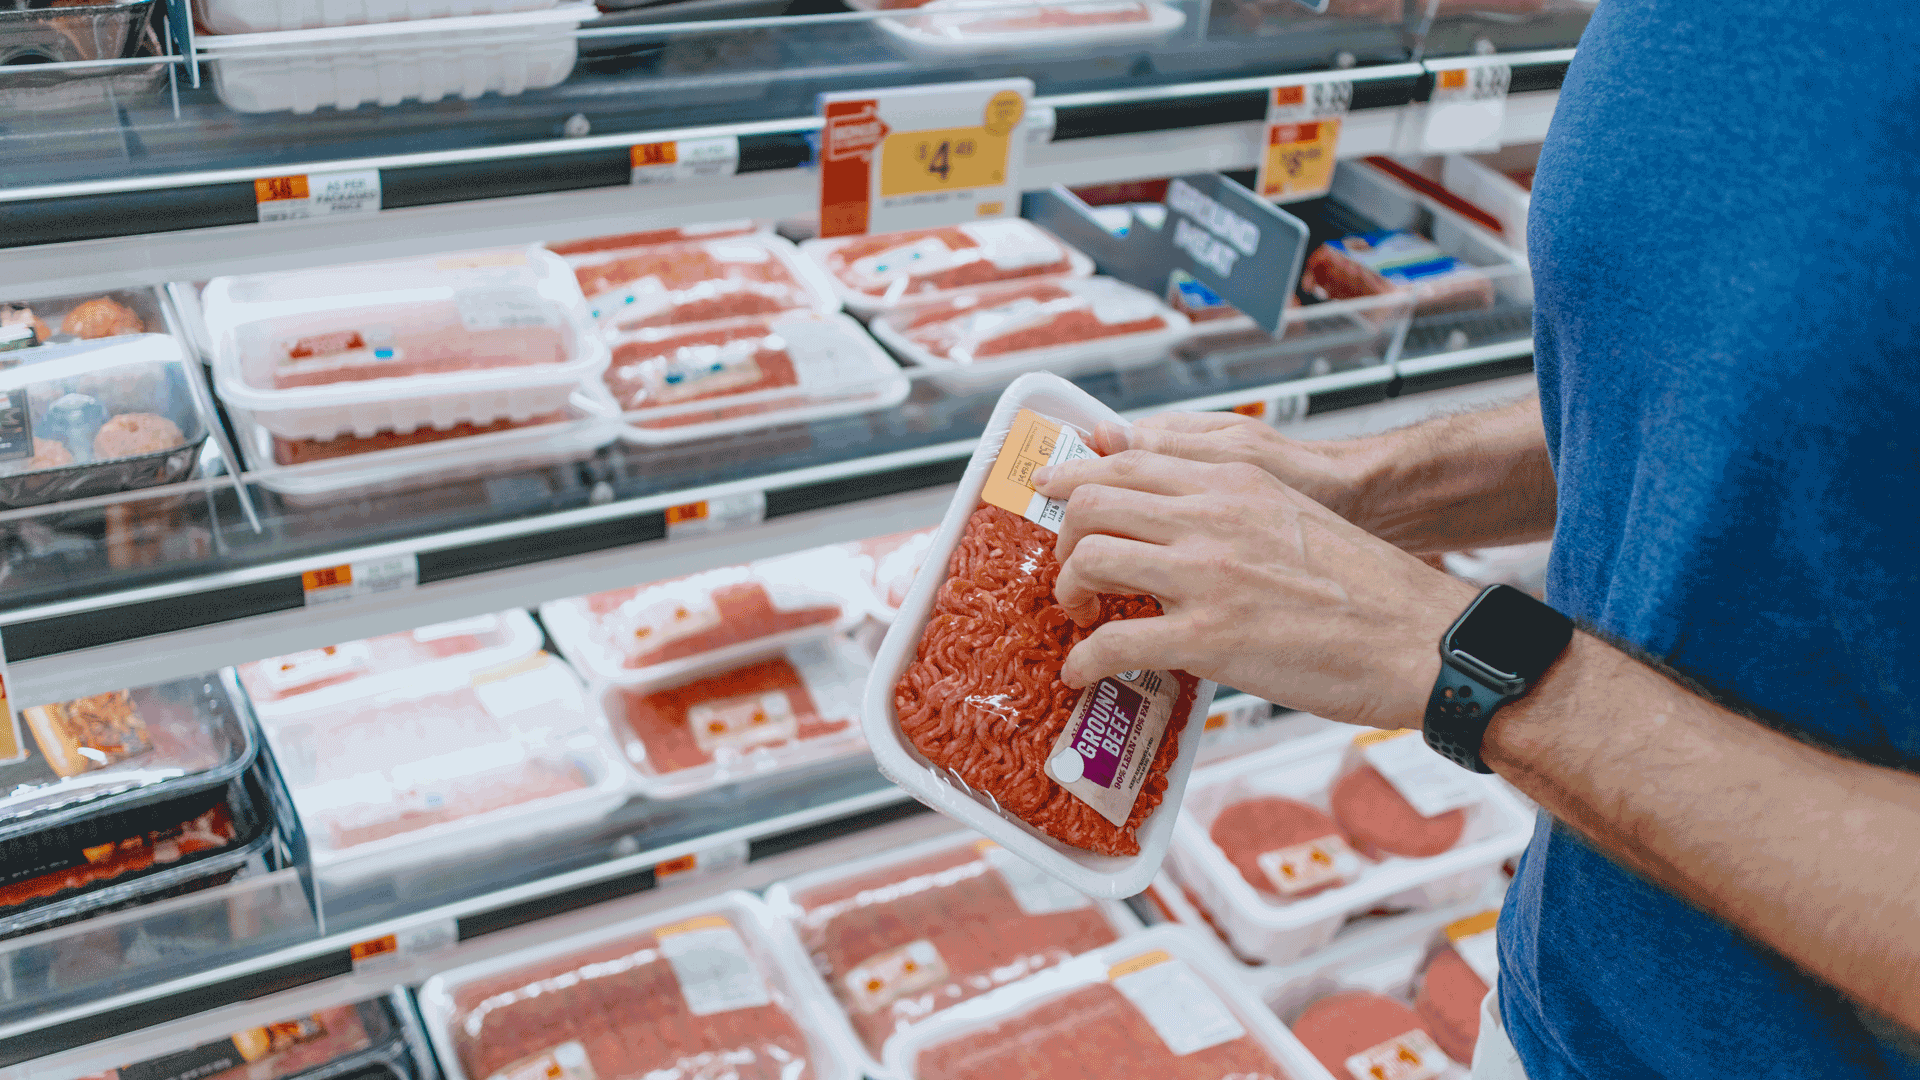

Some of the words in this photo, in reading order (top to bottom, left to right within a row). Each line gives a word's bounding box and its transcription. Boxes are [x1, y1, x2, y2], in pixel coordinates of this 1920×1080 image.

[1168, 178, 1260, 256] GROUND
[1174, 218, 1239, 277] MEAT
[1071, 723, 1081, 739] ALL
[1078, 681, 1097, 721] NATURAL
[1076, 681, 1119, 759] GROUND
[1101, 706, 1131, 758] BEEF
[1134, 717, 1146, 737] 10%
[1139, 696, 1152, 717] FAT
[1114, 770, 1127, 790] 90%
[1121, 741, 1137, 771] LEAN
